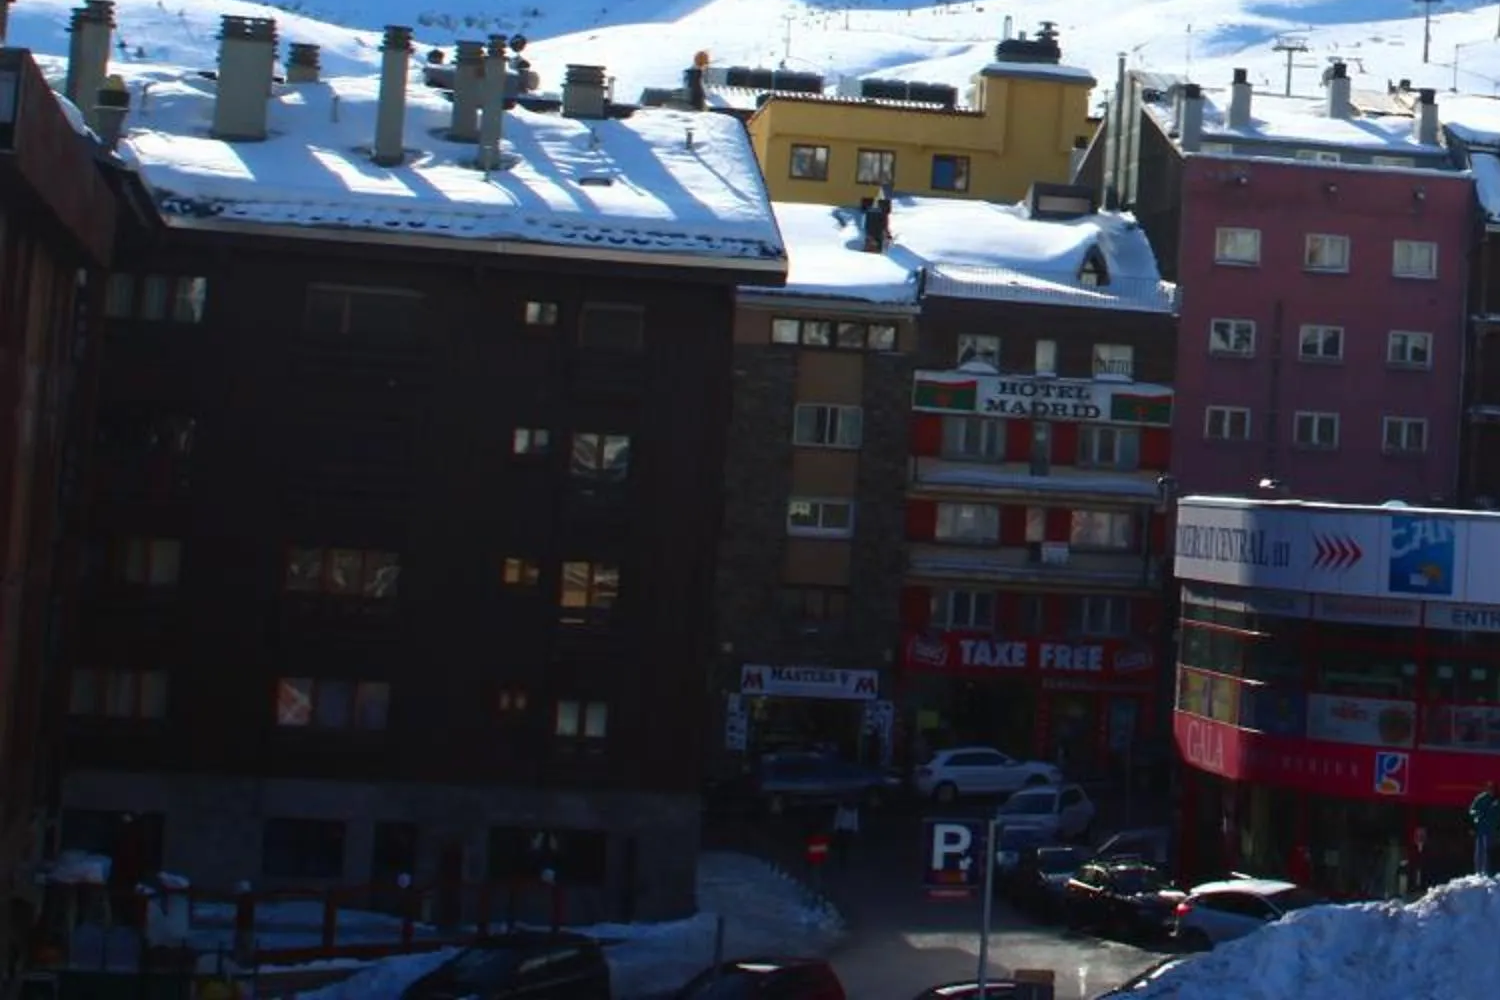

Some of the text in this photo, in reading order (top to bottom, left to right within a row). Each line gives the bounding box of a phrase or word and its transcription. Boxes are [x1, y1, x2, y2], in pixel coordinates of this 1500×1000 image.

[999, 380, 1090, 400] HOTEL
[986, 399, 1100, 419] MADRID
[958, 638, 1029, 668] TAXE
[1038, 644, 1105, 673] FREE
[931, 822, 973, 871] P
